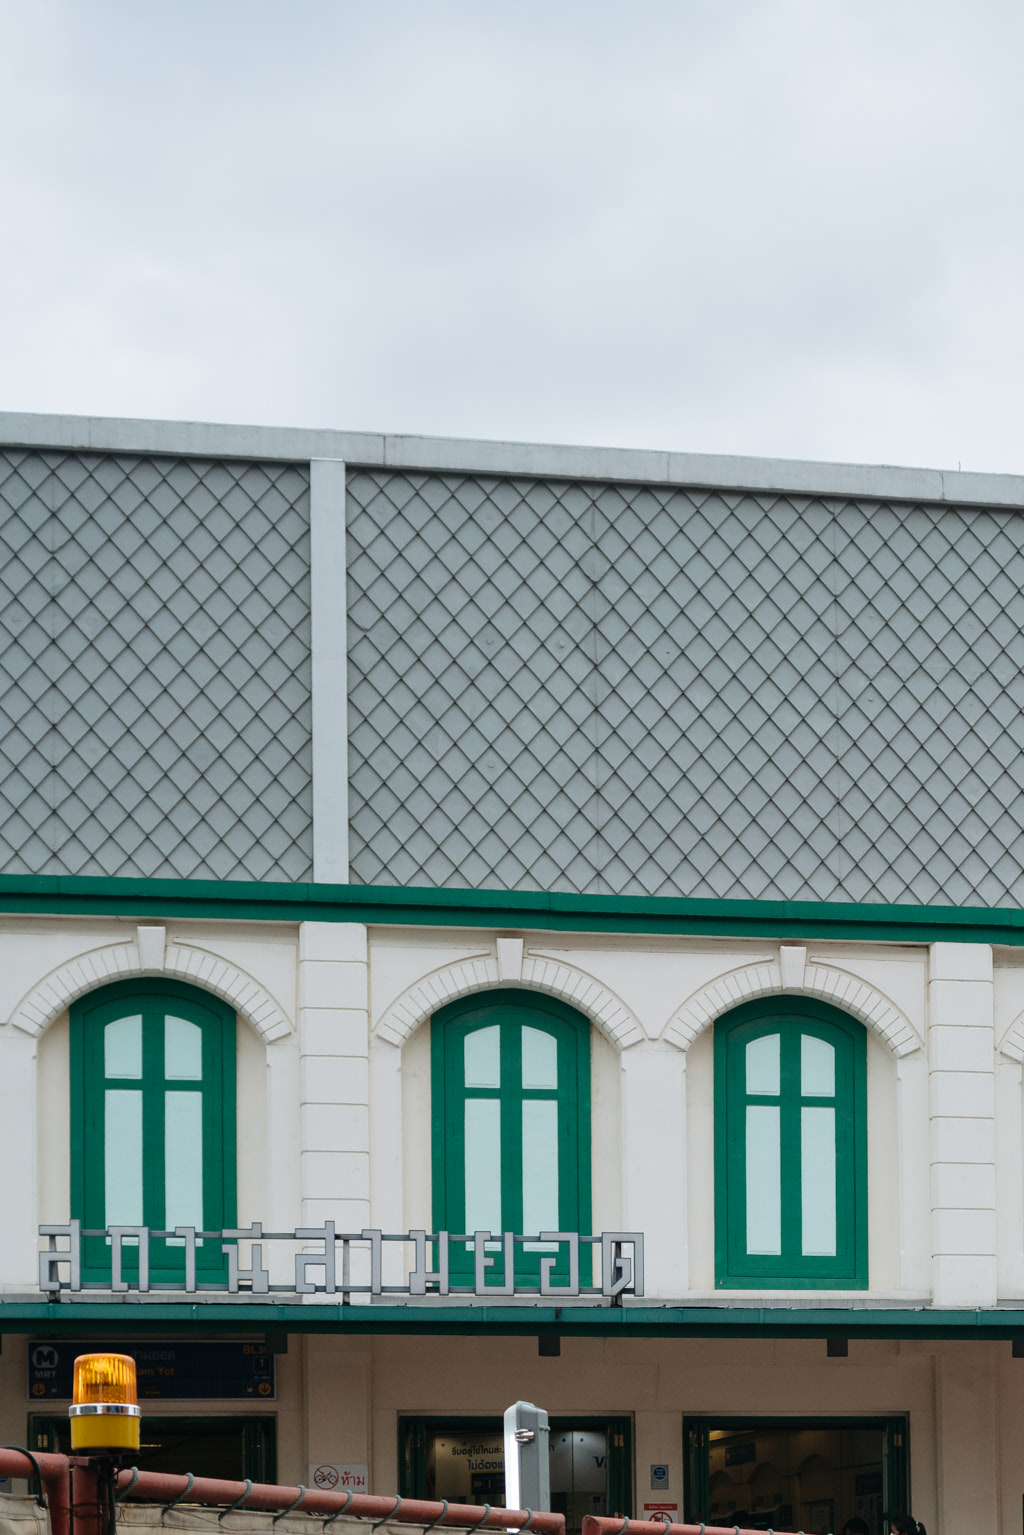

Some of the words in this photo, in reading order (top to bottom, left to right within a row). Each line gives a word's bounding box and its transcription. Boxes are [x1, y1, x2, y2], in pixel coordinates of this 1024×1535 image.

[39, 1219, 644, 1297] สถานีสามยอด
[242, 1345, 266, 1354] BL3
[34, 1370, 56, 1378] MRT
[136, 1368, 155, 1376] am
[158, 1367, 175, 1376] Yot
